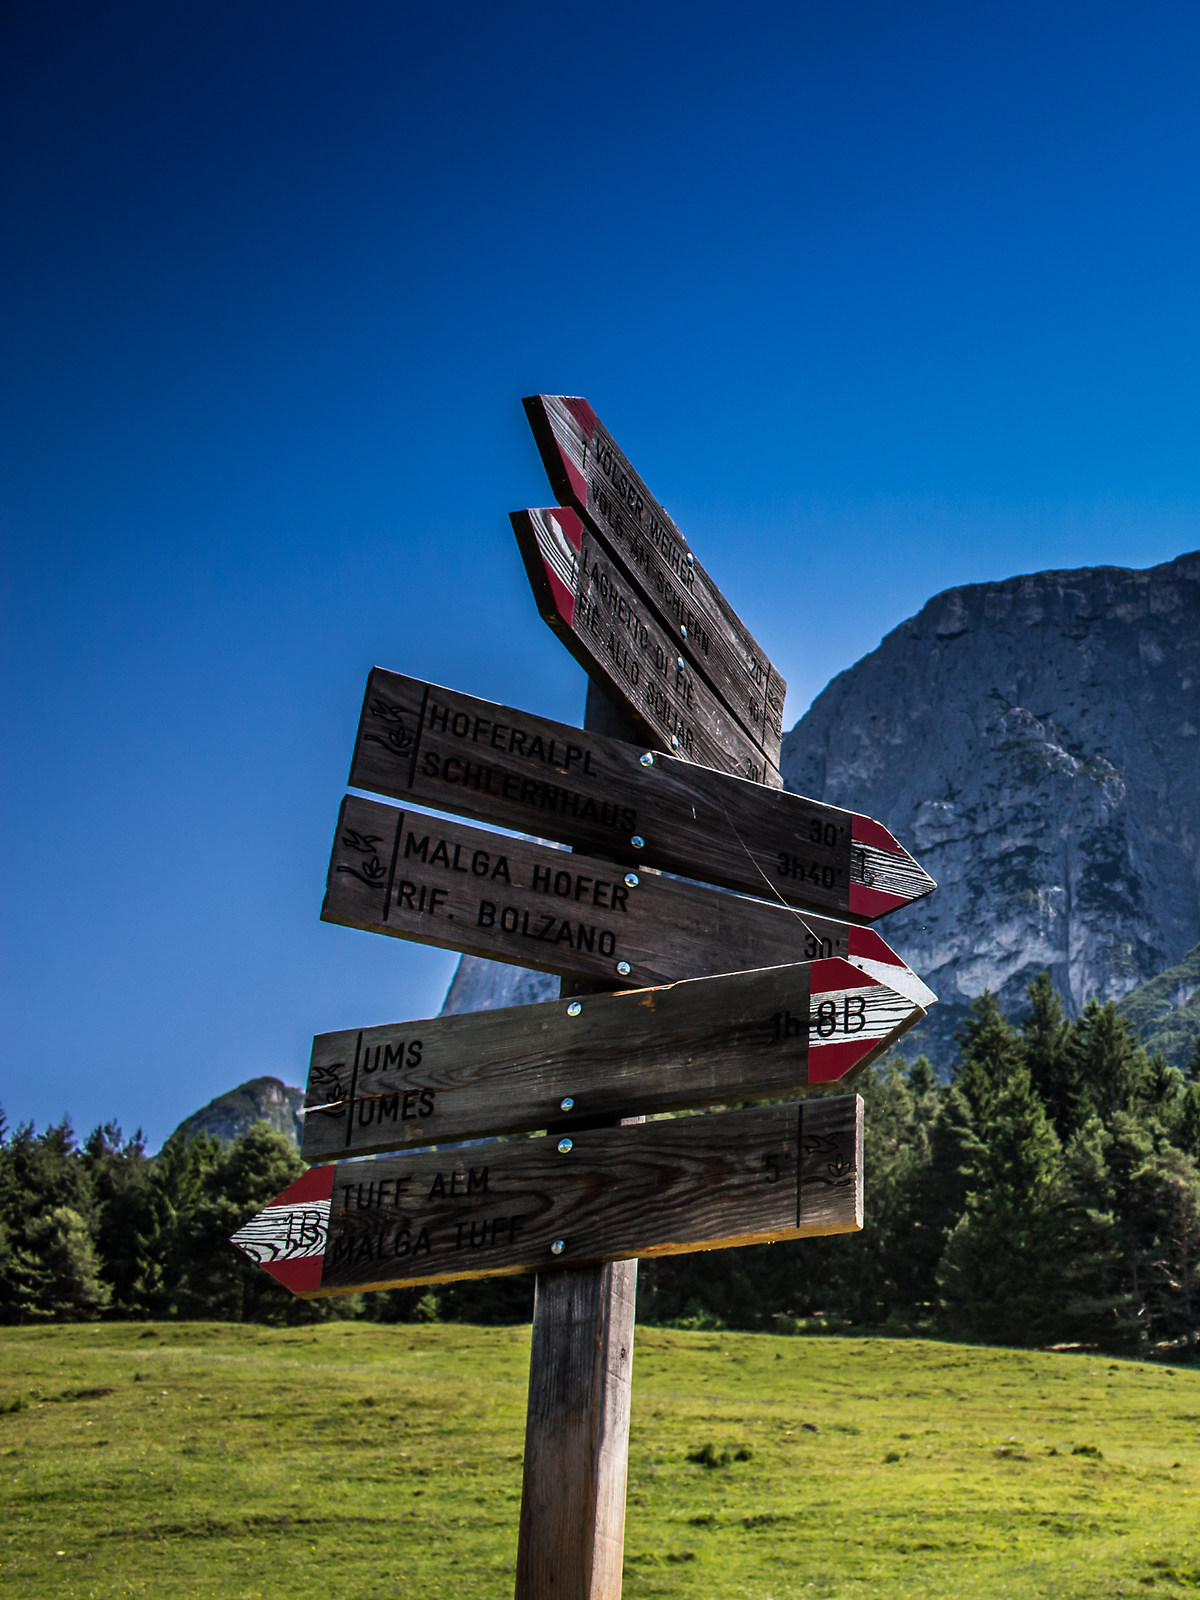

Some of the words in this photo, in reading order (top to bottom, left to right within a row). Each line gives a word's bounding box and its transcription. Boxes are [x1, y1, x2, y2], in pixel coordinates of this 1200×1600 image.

[596, 438, 644, 522] VÖLSER
[650, 516, 695, 595] WEIHER
[592, 479, 624, 537] VÖLS
[630, 537, 650, 573] AM
[657, 571, 709, 655] SCHLERN
[583, 550, 648, 649] LAGHETTO
[656, 644, 669, 678] DI
[606, 632, 639, 686] ALLO
[647, 681, 694, 756] SCILIAR
[429, 705, 597, 778] HOFERALPL
[422, 751, 638, 833] SCHLERNHAUS
[404, 832, 511, 883] MALGA
[532, 864, 629, 912] HOFER
[396, 880, 454, 919] RIF.
[478, 900, 616, 958] BOLZANO
[817, 996, 866, 1037] 8B
[364, 1041, 423, 1073] UMS
[359, 1088, 435, 1126] UMES
[342, 1177, 411, 1211] TUFF
[428, 1167, 489, 1200] ALM
[332, 1227, 431, 1265] MALGA
[455, 1214, 527, 1250] TUFF
